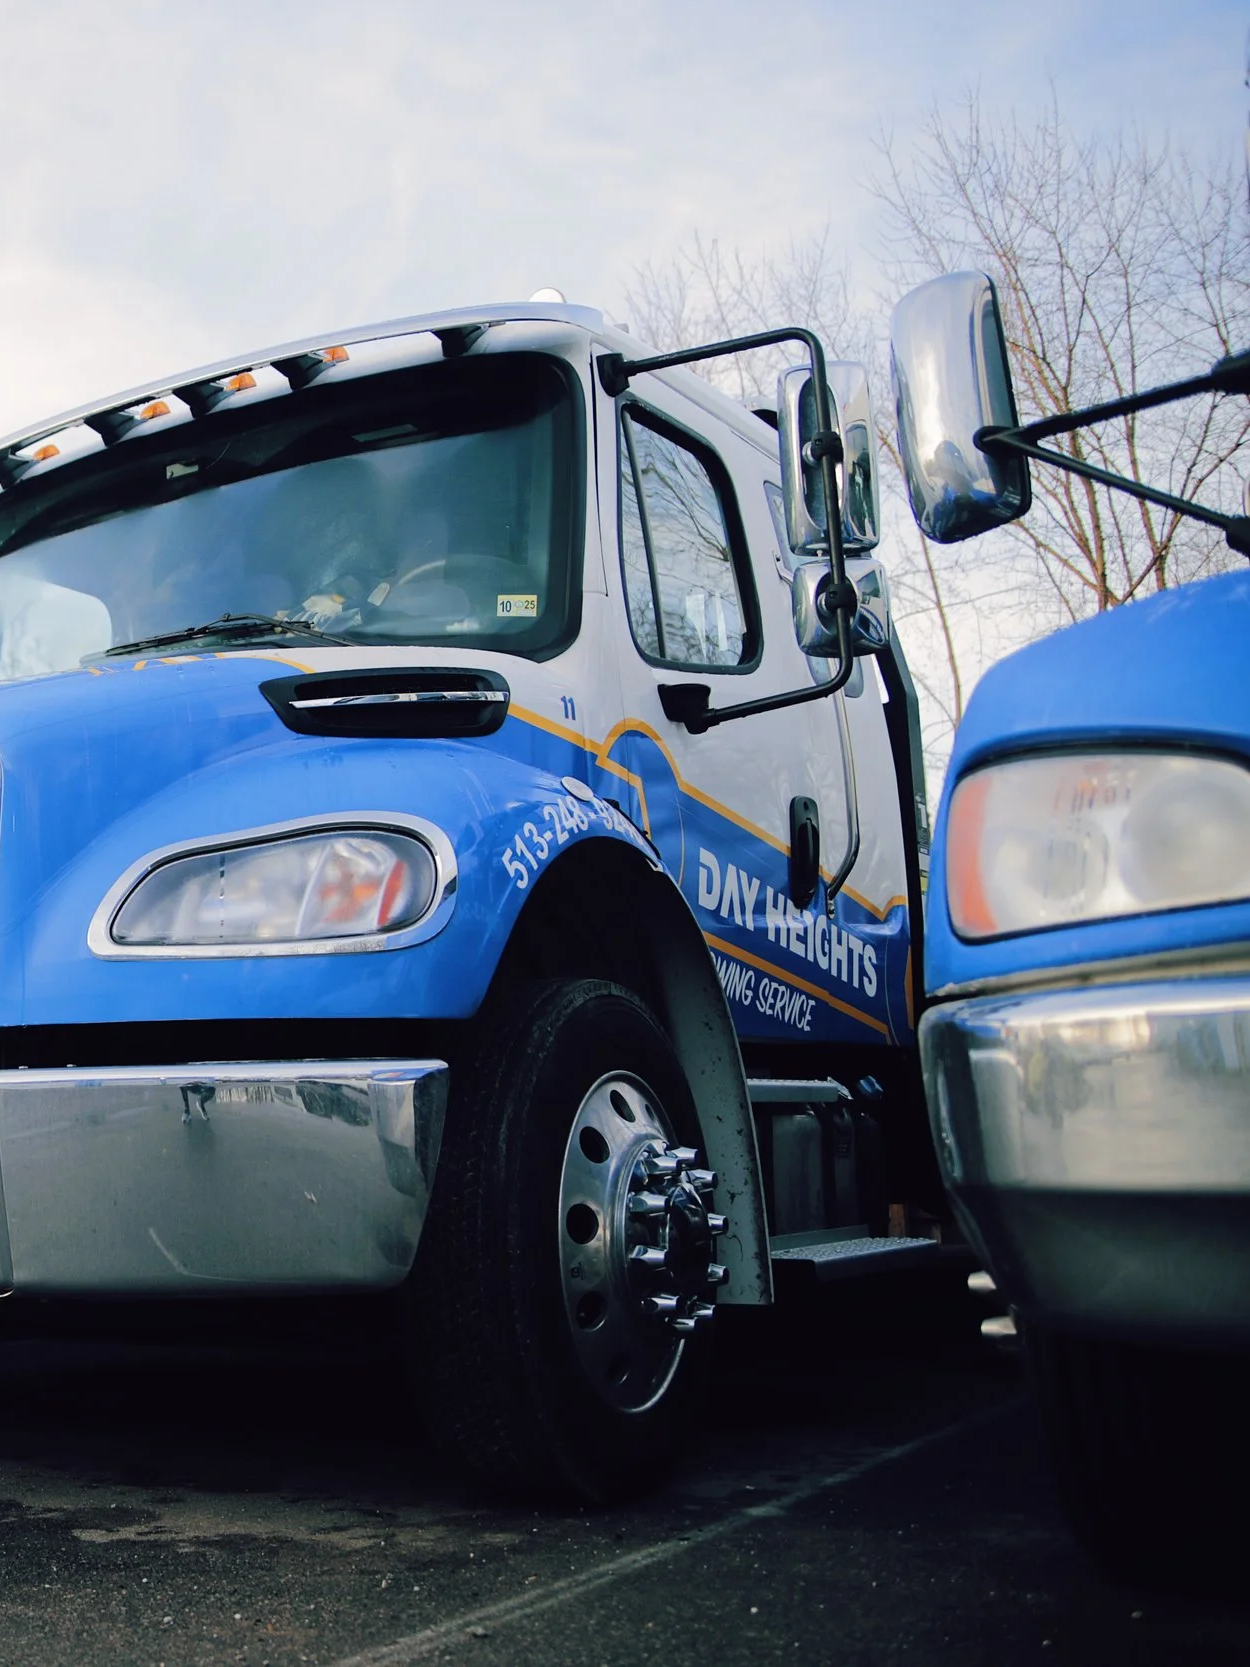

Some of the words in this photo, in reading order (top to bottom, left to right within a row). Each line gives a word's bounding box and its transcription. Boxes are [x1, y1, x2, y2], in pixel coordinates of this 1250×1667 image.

[500, 600, 512, 613] 10
[524, 600, 536, 610] 25
[561, 696, 576, 721] 11
[698, 847, 761, 932] DAY
[766, 885, 877, 998] HEIGHTS
[756, 977, 816, 1032] SERVICE
